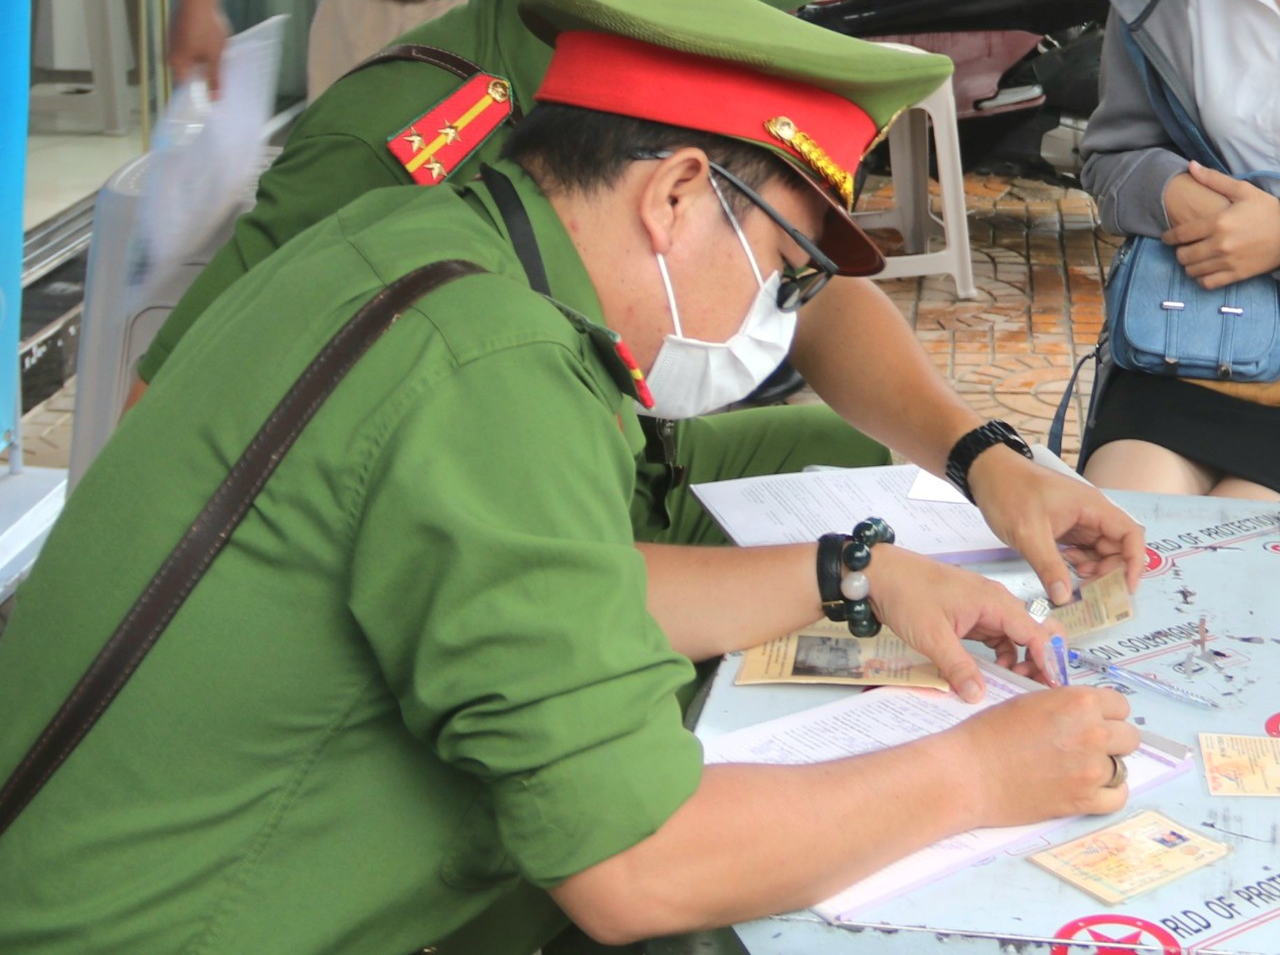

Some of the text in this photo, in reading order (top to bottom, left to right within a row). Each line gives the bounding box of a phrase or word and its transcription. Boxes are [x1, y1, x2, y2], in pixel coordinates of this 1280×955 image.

[1177, 530, 1204, 546] OF
[1160, 909, 1213, 939] RLD
[1204, 895, 1243, 920] OF
